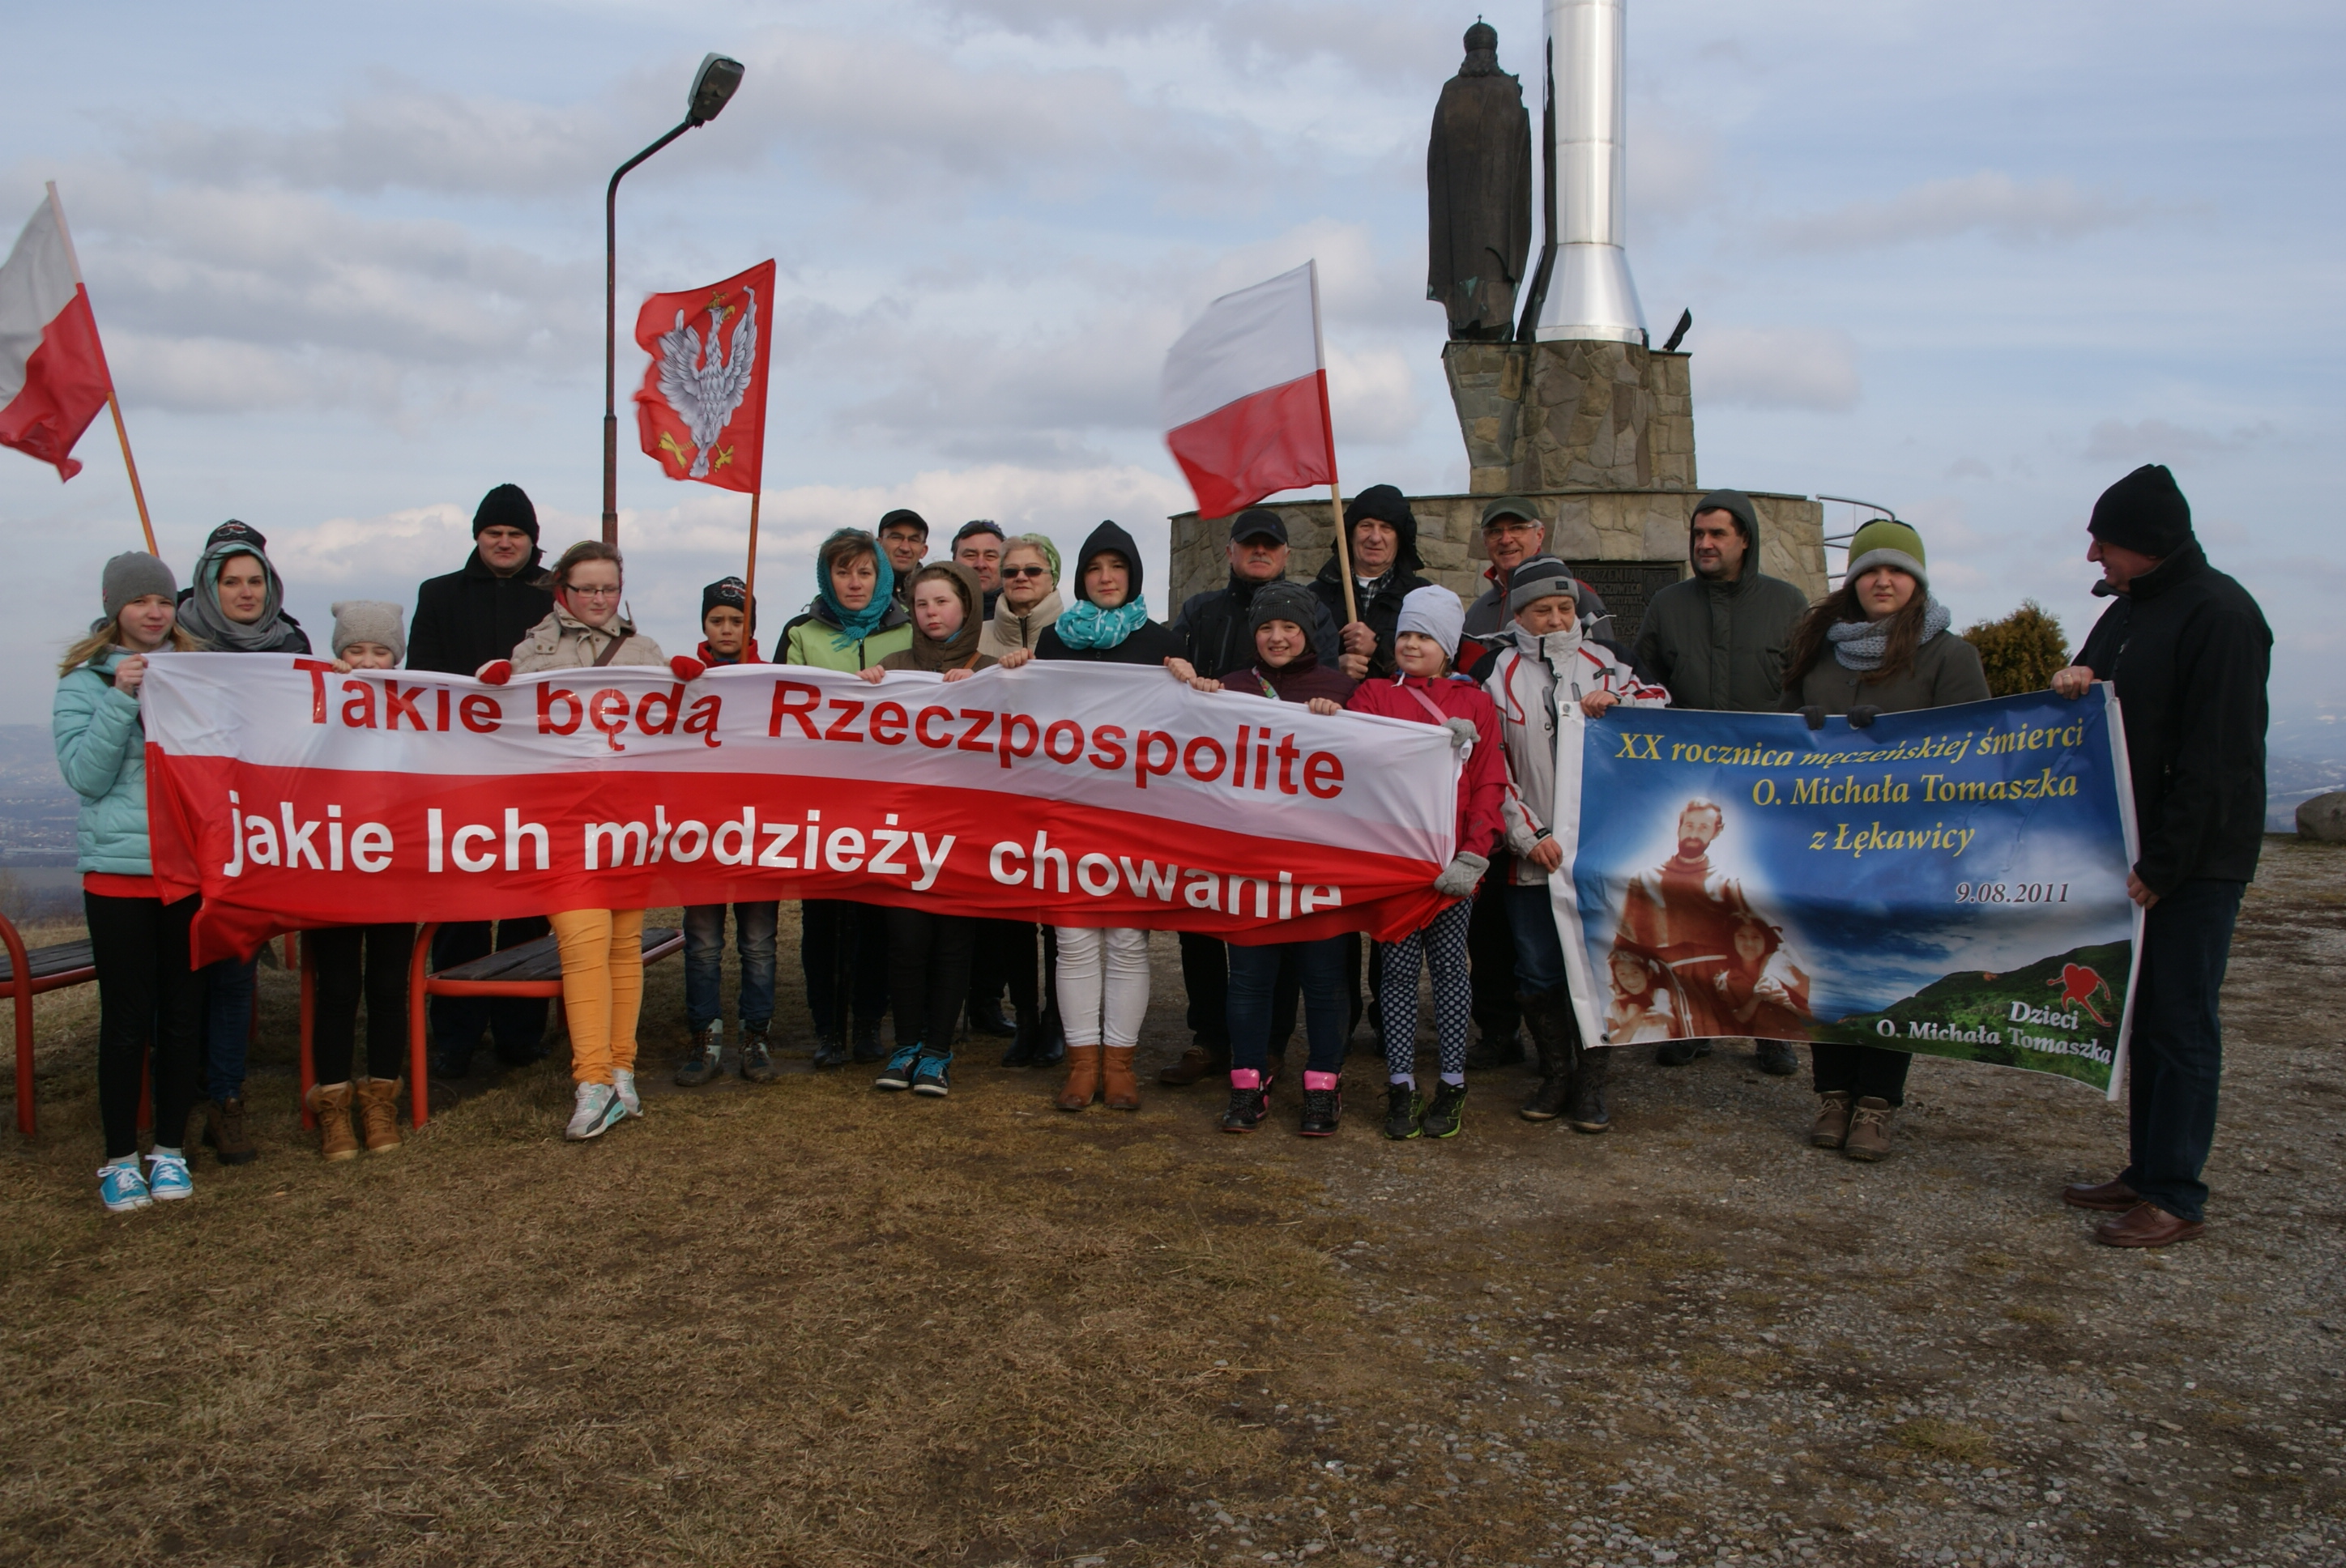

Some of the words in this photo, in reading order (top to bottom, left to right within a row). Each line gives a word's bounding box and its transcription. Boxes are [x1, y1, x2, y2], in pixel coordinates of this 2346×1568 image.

[292, 658, 502, 734] Takie
[536, 681, 723, 752] będą
[768, 680, 1345, 799] Rzeczpospolite
[1614, 732, 1663, 761] XX
[1671, 739, 1794, 768] rocznica
[1798, 731, 1973, 770] męczeńskiej
[1976, 717, 2084, 756] śmierci
[1752, 778, 1781, 807] O.
[1791, 775, 1911, 805] Michała
[1920, 767, 2078, 803] Tomaszka
[224, 789, 394, 877] jakie
[428, 807, 550, 873] Ich
[585, 805, 957, 892] młodzieży
[989, 829, 1343, 920] chowanie
[1809, 829, 1825, 850] z
[1832, 820, 1976, 858] Łękawicy
[1955, 881, 2070, 905] 9.08.2011
[2008, 1000, 2079, 1031] Dzieci
[1876, 1018, 1901, 1039] O.
[1909, 1020, 2002, 1046] Michała
[2007, 1026, 2113, 1066] Tomaszka
